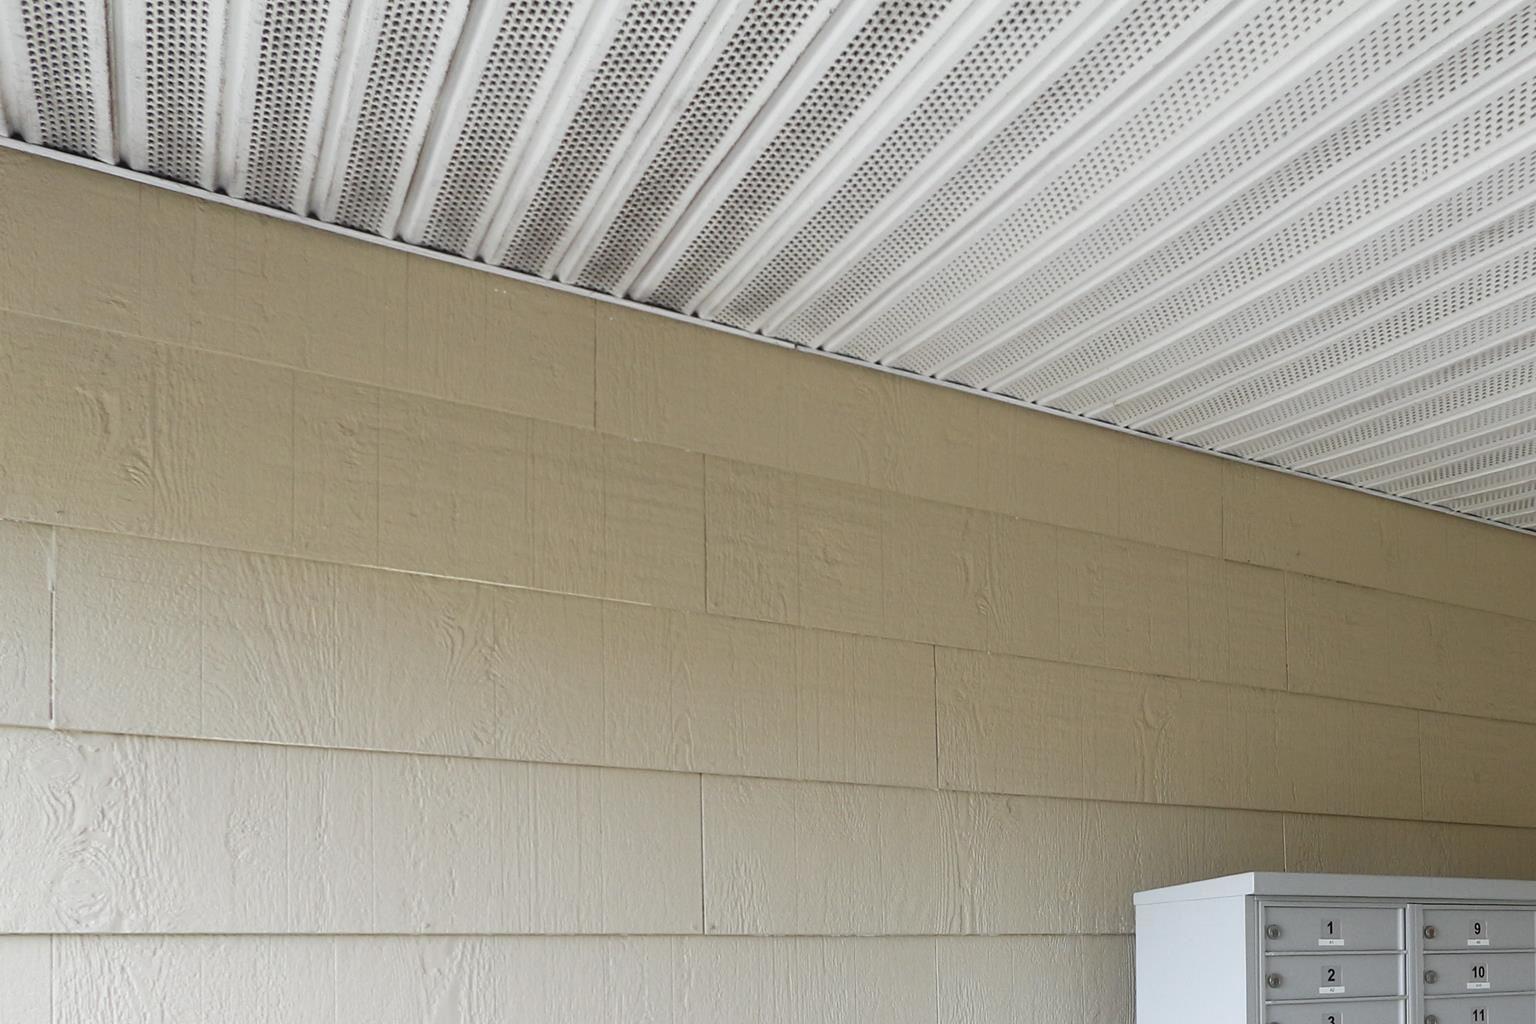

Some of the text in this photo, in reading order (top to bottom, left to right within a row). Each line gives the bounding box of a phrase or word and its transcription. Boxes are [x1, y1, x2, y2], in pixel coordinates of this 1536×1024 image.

[1327, 920, 1333, 935] 1
[1474, 922, 1481, 935] 9
[1327, 968, 1336, 982] 2
[1471, 965, 1485, 979] 10
[1472, 1008, 1485, 1022] 11
